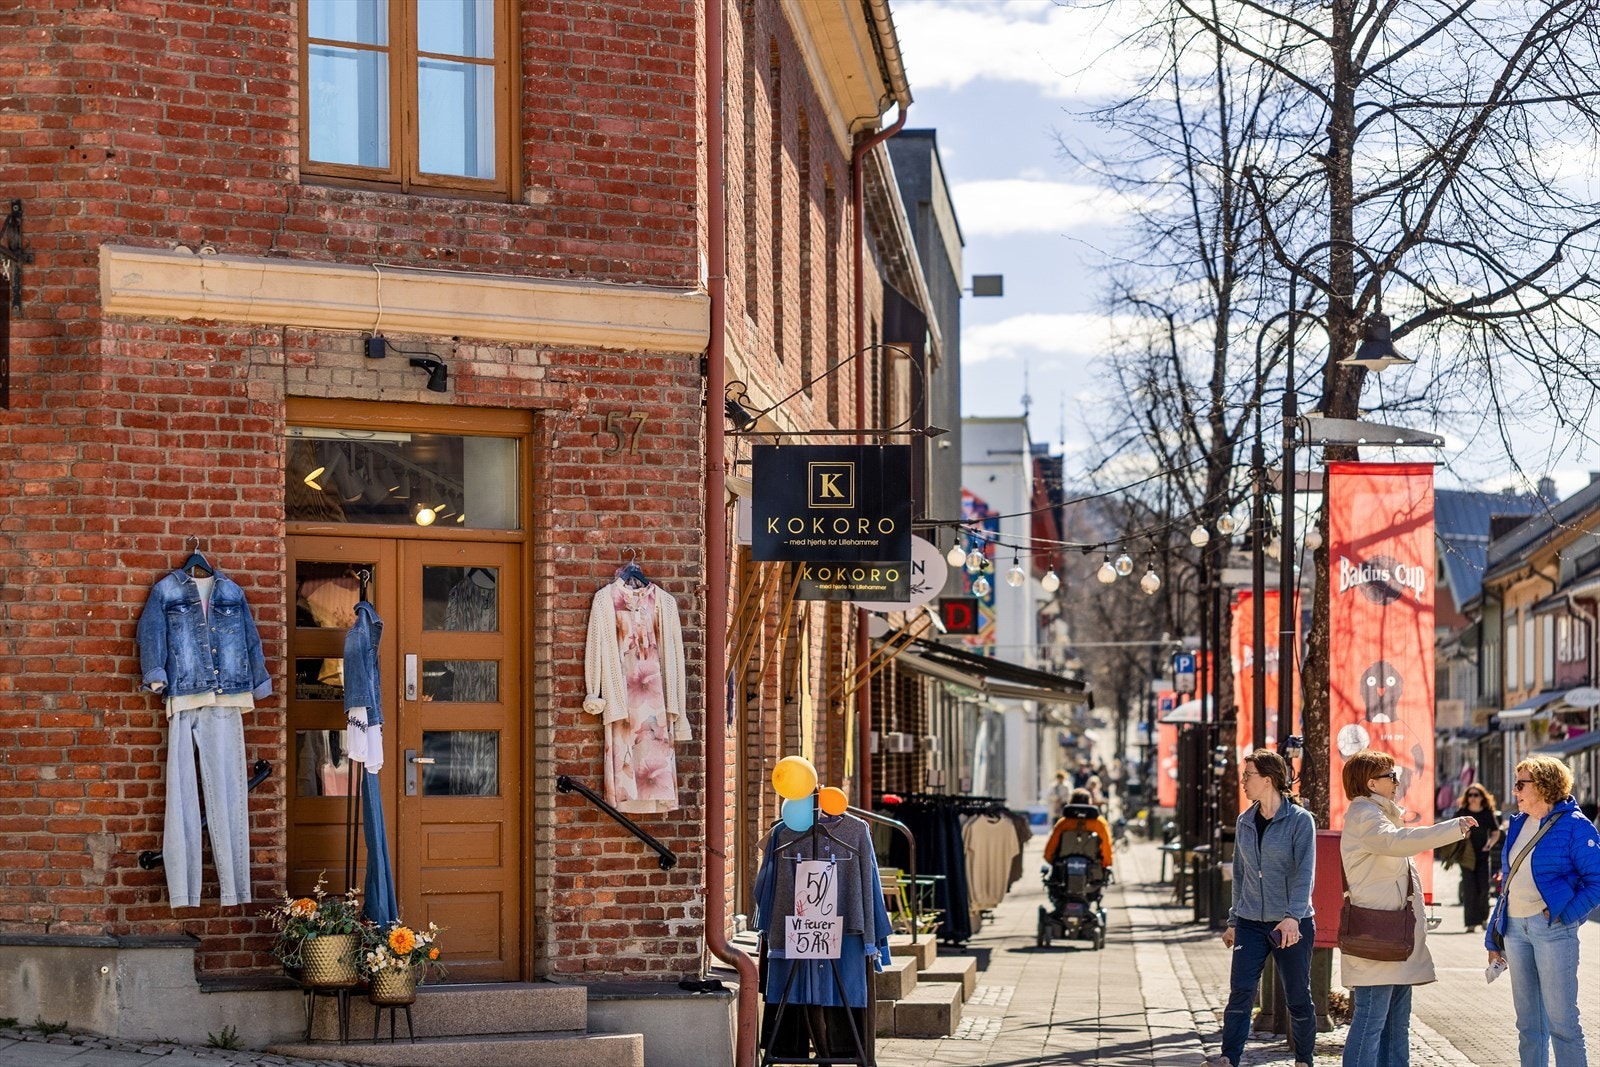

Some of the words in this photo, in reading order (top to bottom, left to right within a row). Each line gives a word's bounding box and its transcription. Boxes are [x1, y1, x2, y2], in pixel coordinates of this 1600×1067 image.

[604, 411, 650, 457] 57
[819, 473, 845, 498] K
[767, 517, 895, 534] KOKORO
[789, 538, 806, 546] med
[807, 538, 827, 547] hjerte
[827, 538, 838, 546] for
[838, 538, 879, 546] Lillehammer
[803, 567, 899, 582] KOKORO
[1340, 555, 1391, 594] Baldus
[1394, 564, 1425, 605] Cup
[832, 583, 848, 591] hjerte
[944, 603, 972, 629] D
[1180, 657, 1190, 671] P
[796, 932, 810, 953] 5
